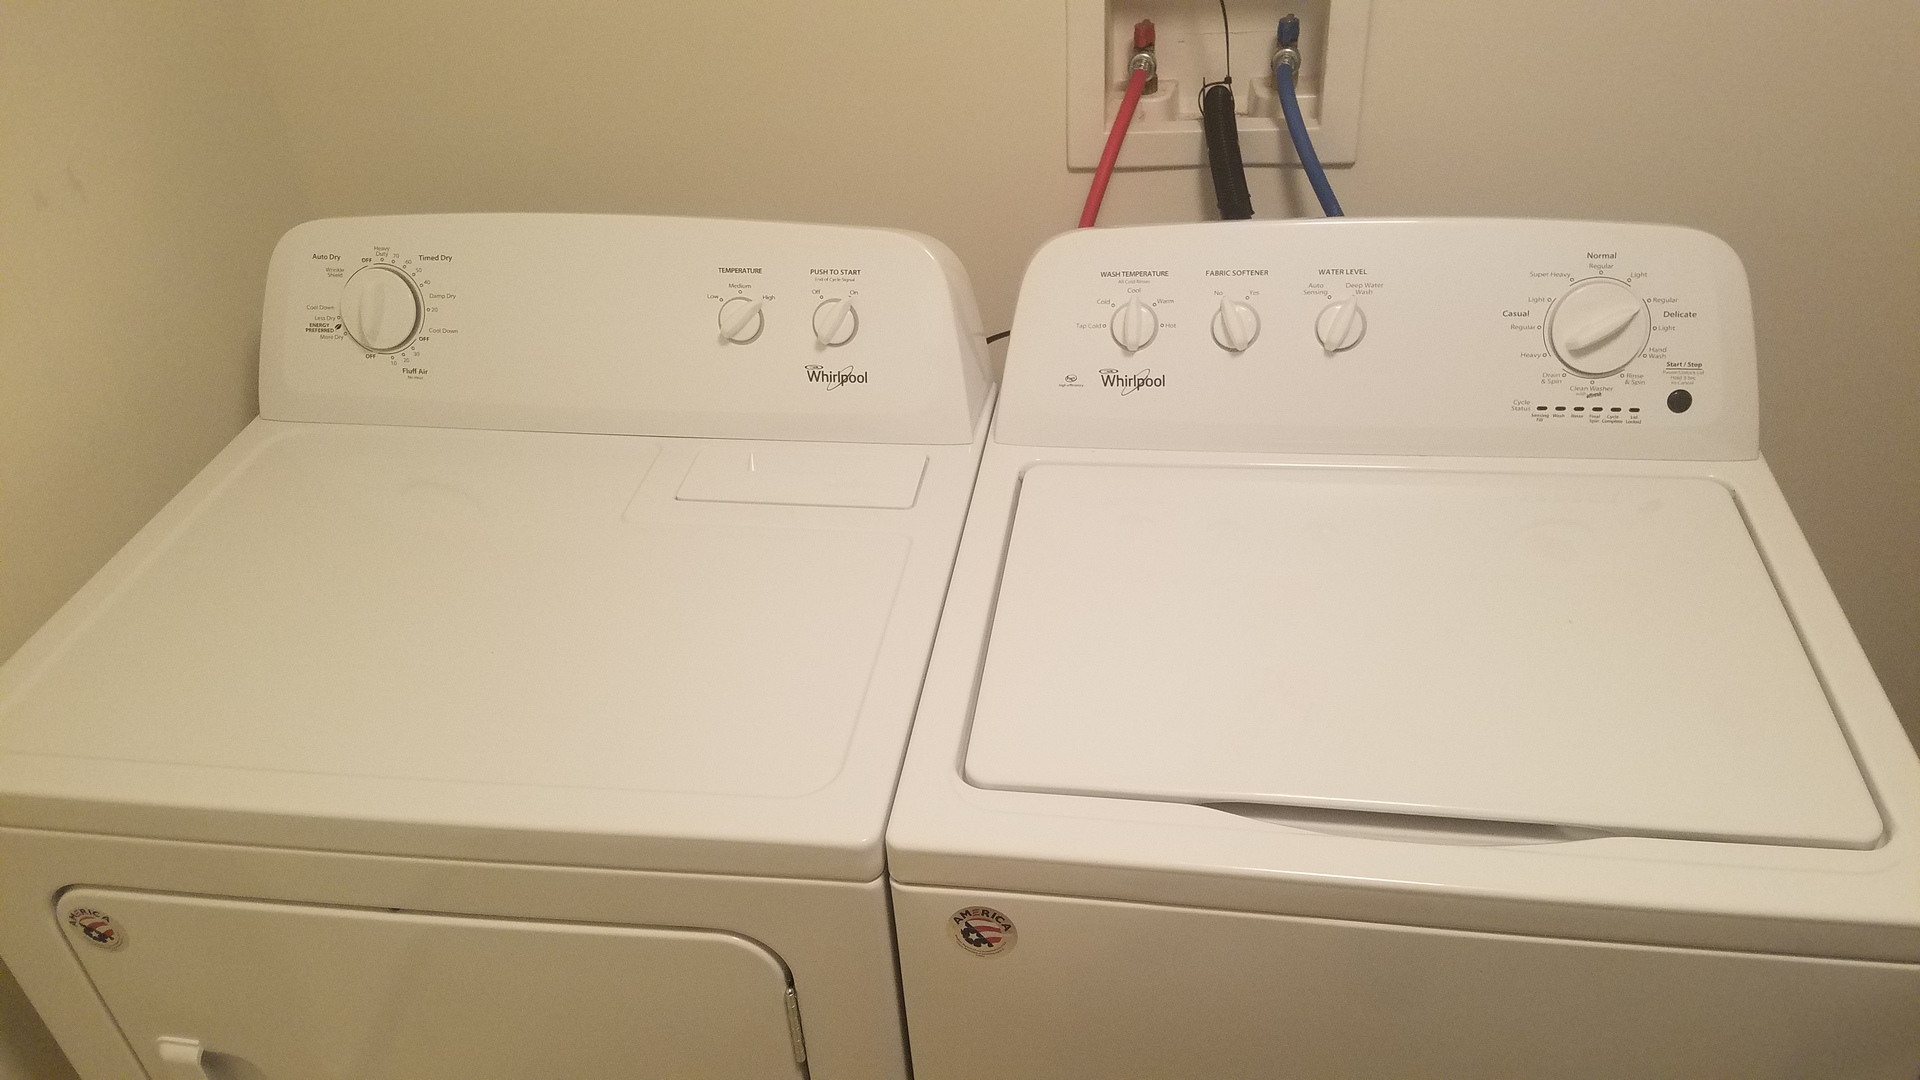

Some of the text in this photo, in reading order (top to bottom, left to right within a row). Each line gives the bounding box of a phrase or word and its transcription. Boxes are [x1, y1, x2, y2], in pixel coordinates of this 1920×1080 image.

[1121, 270, 1169, 278] TEMPERATURE
[1631, 271, 1647, 279] Light
[402, 367, 417, 375] Fluff
[806, 367, 868, 388] Whirlpool
[1101, 373, 1166, 392] Whirlpool
[68, 908, 110, 927] AMERICA
[953, 909, 1012, 932] AMERICA
